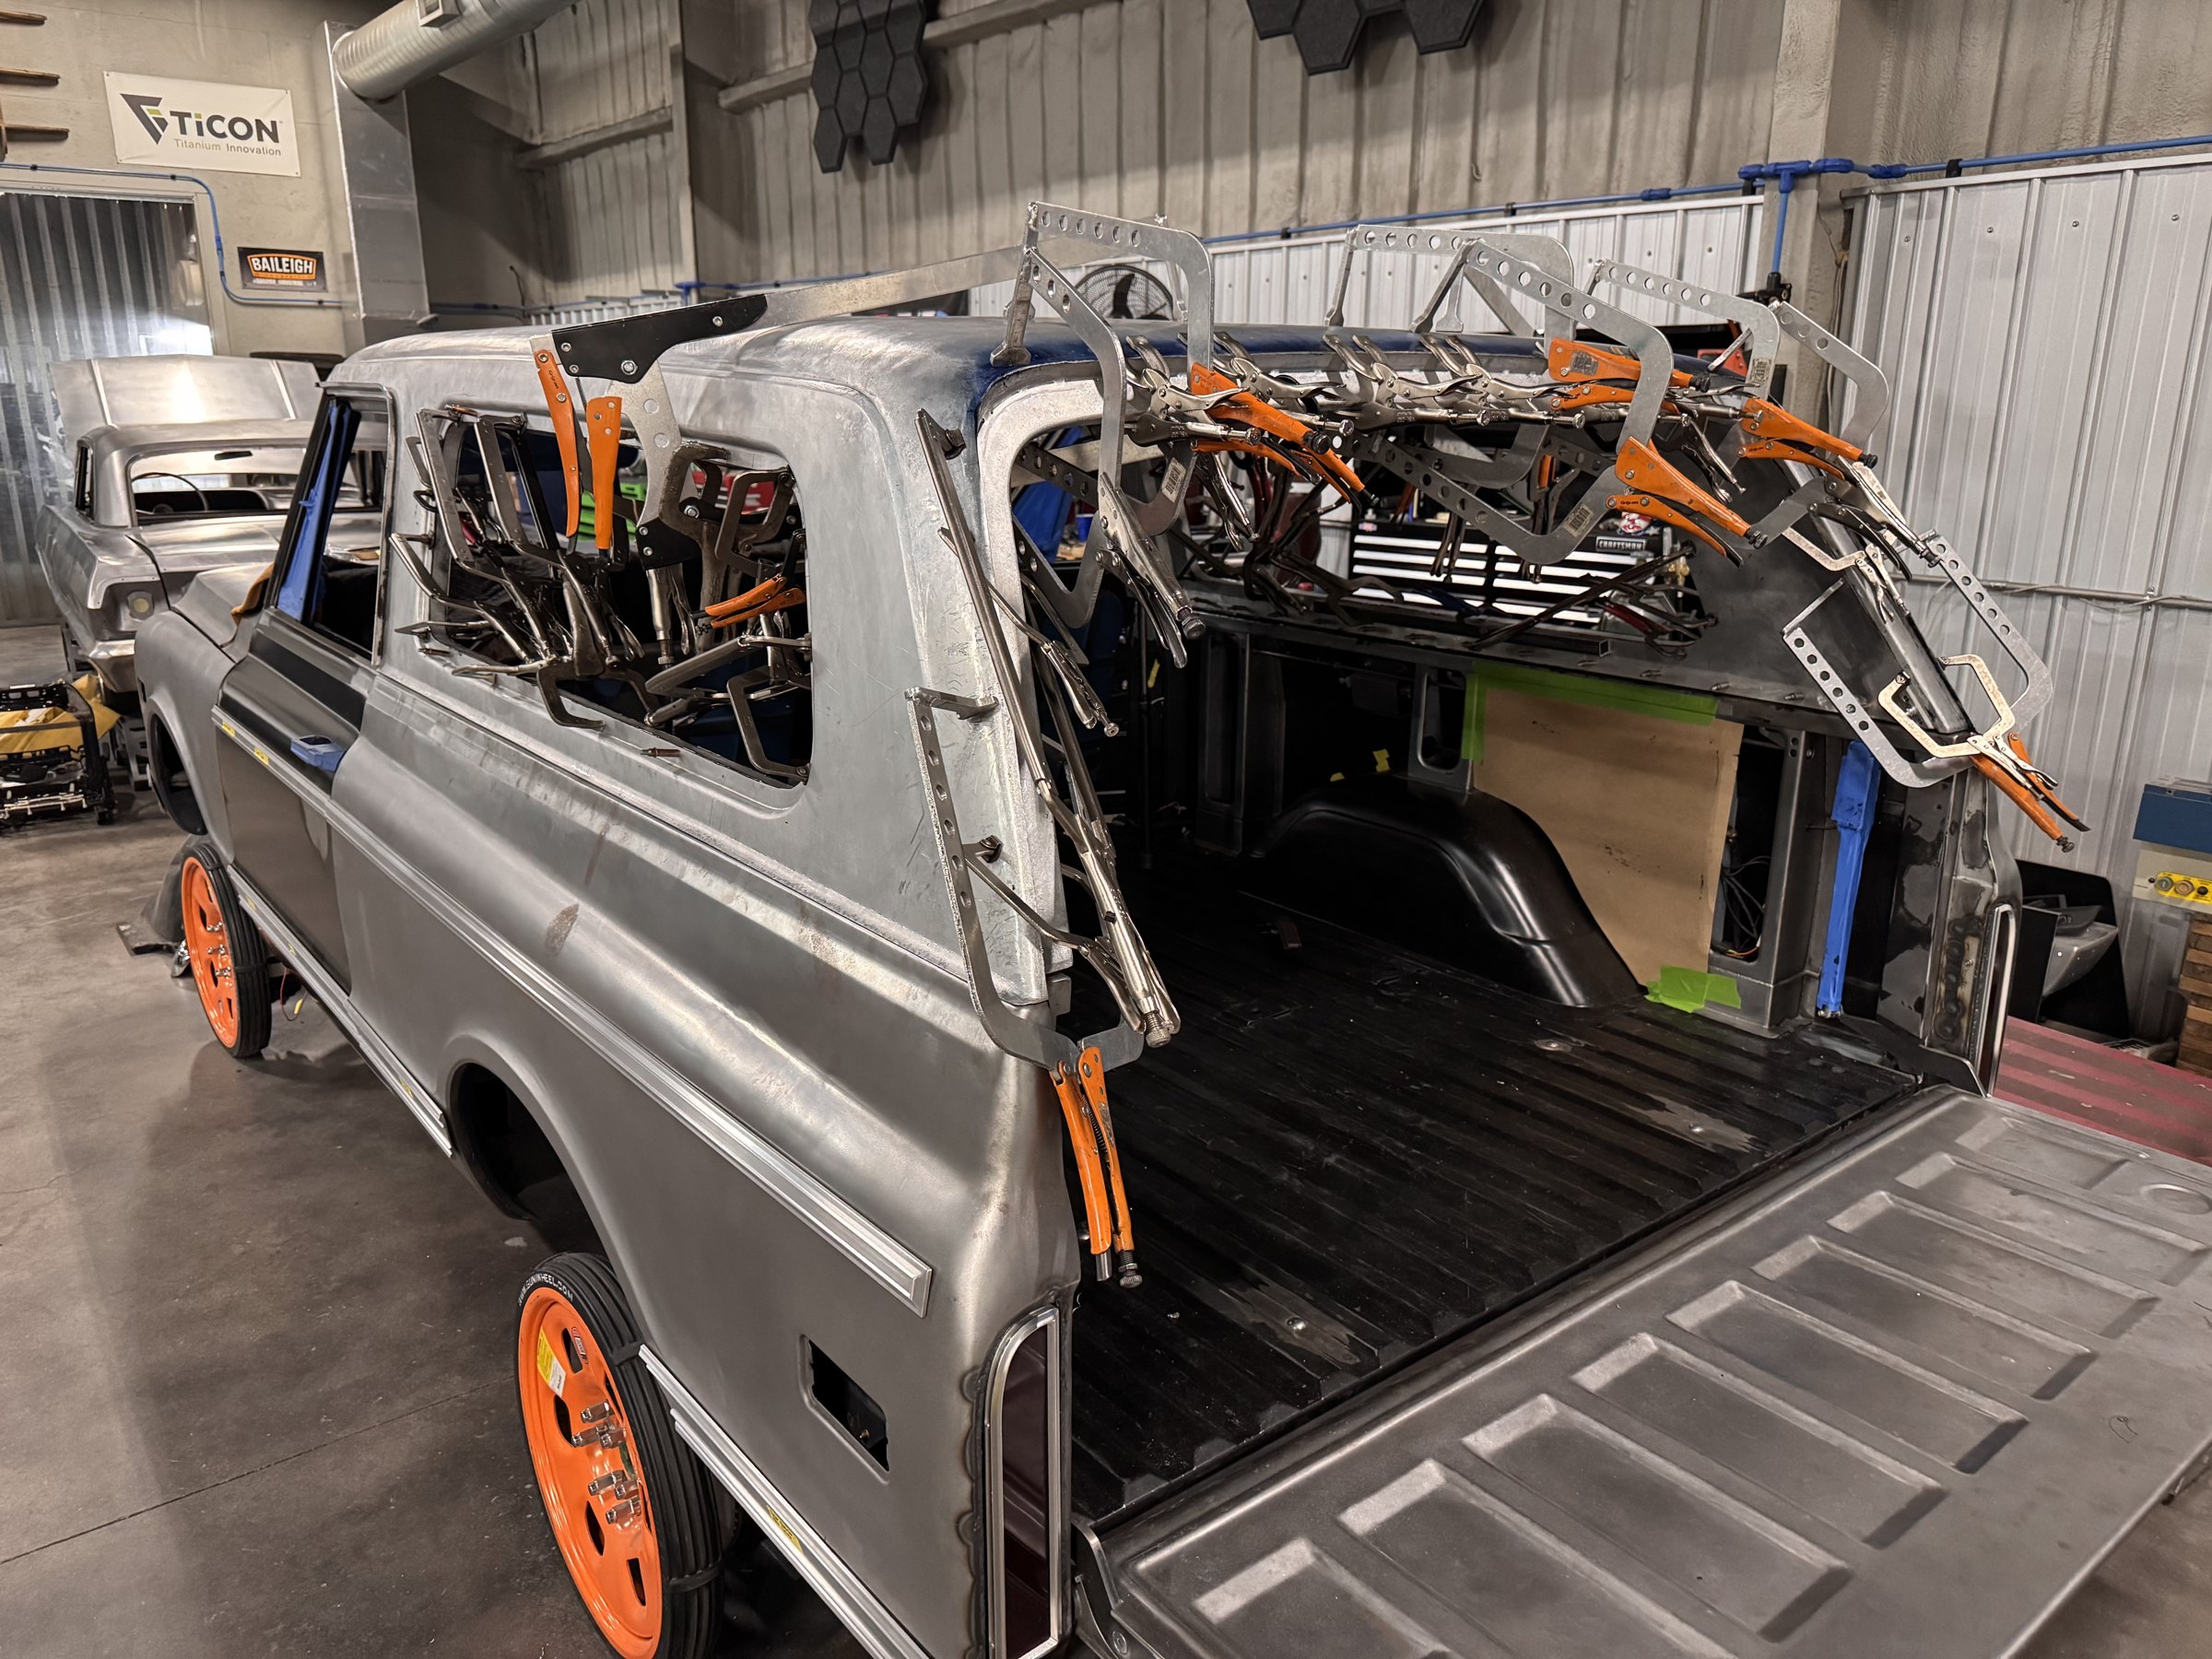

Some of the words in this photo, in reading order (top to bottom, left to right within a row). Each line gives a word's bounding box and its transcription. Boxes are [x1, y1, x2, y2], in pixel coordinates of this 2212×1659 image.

[173, 138, 221, 151] Titanium
[226, 143, 281, 156] Innovation
[252, 256, 313, 274] BAILEIGH
[1599, 540, 1641, 551] CRAFTSMAN
